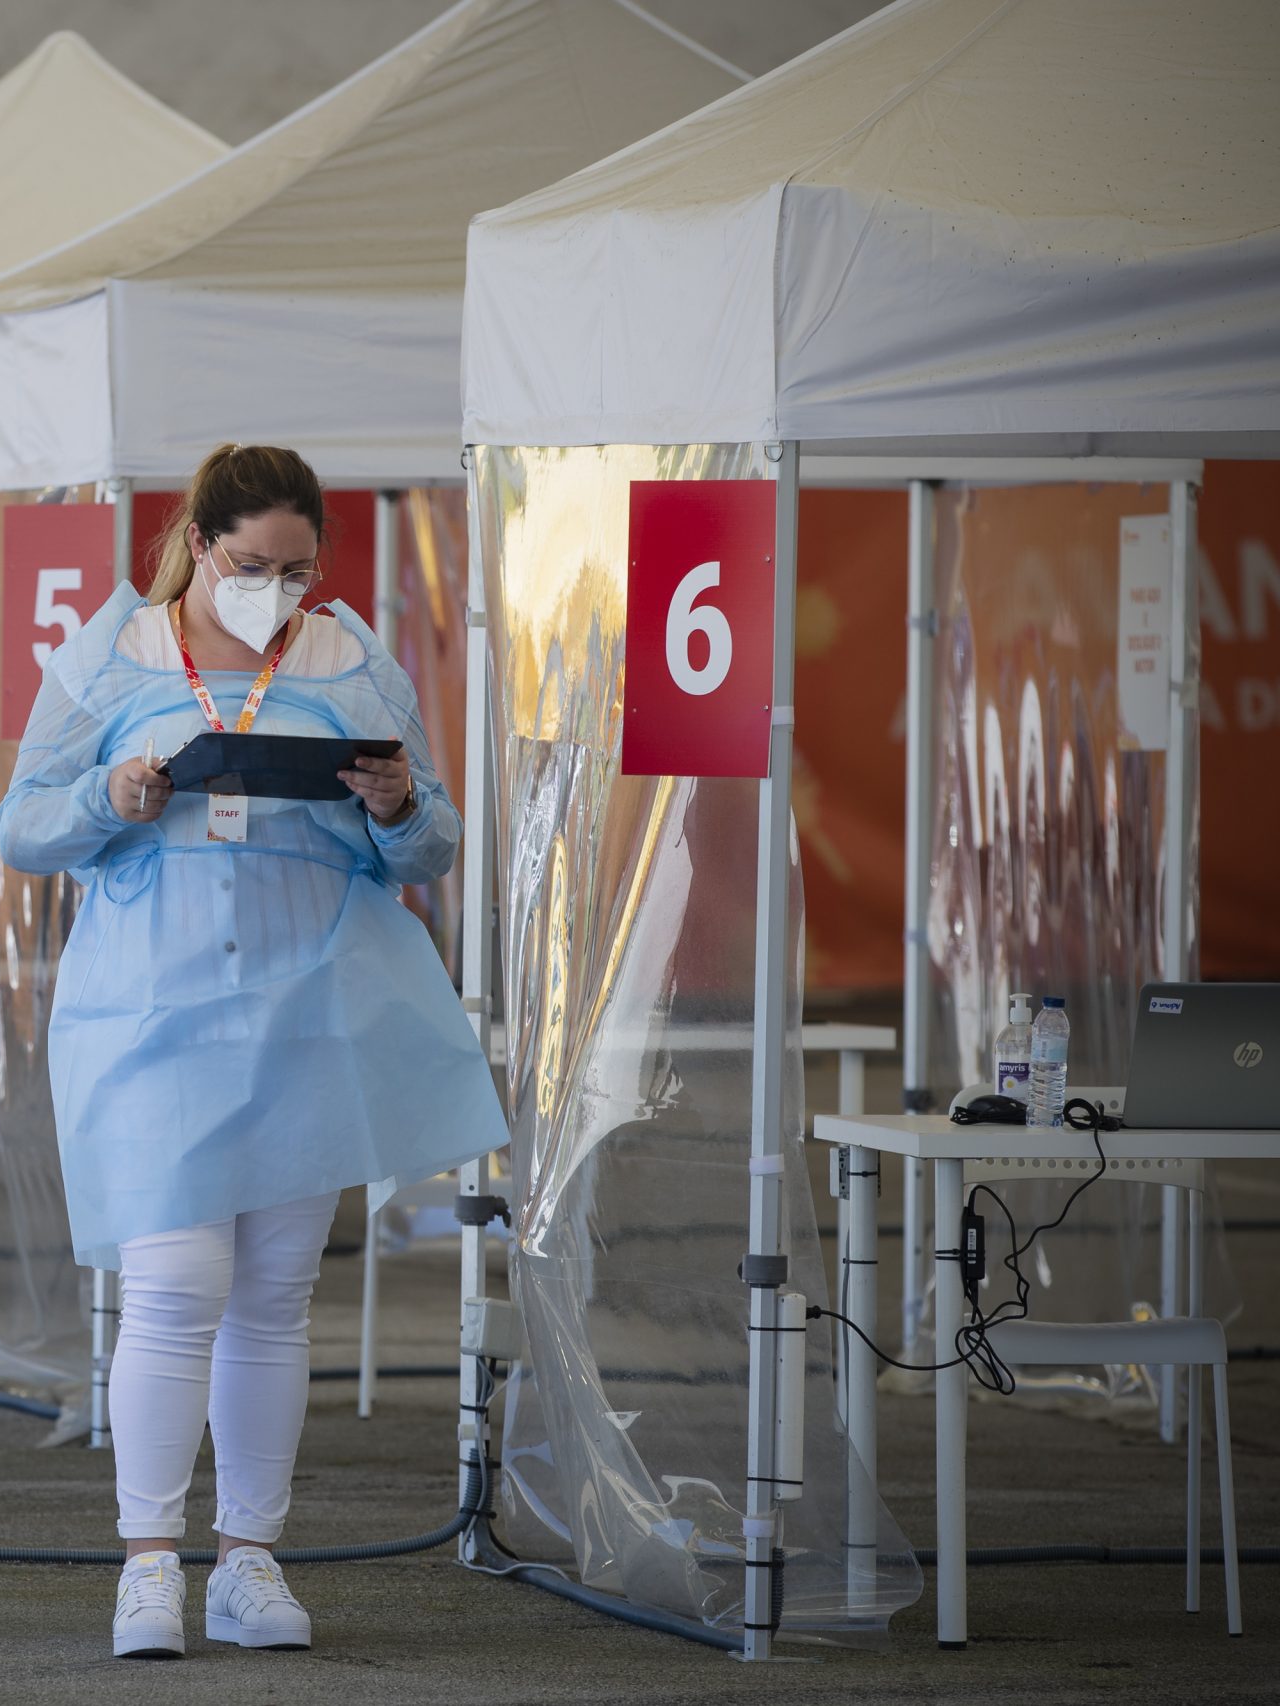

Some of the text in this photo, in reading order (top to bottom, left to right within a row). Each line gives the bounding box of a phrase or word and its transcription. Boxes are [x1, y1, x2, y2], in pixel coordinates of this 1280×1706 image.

[31, 567, 83, 671] 5
[665, 560, 733, 696] 6
[214, 810, 240, 818] STAFF
[999, 1064, 1026, 1073] amyris
[1236, 1041, 1261, 1069] hp
